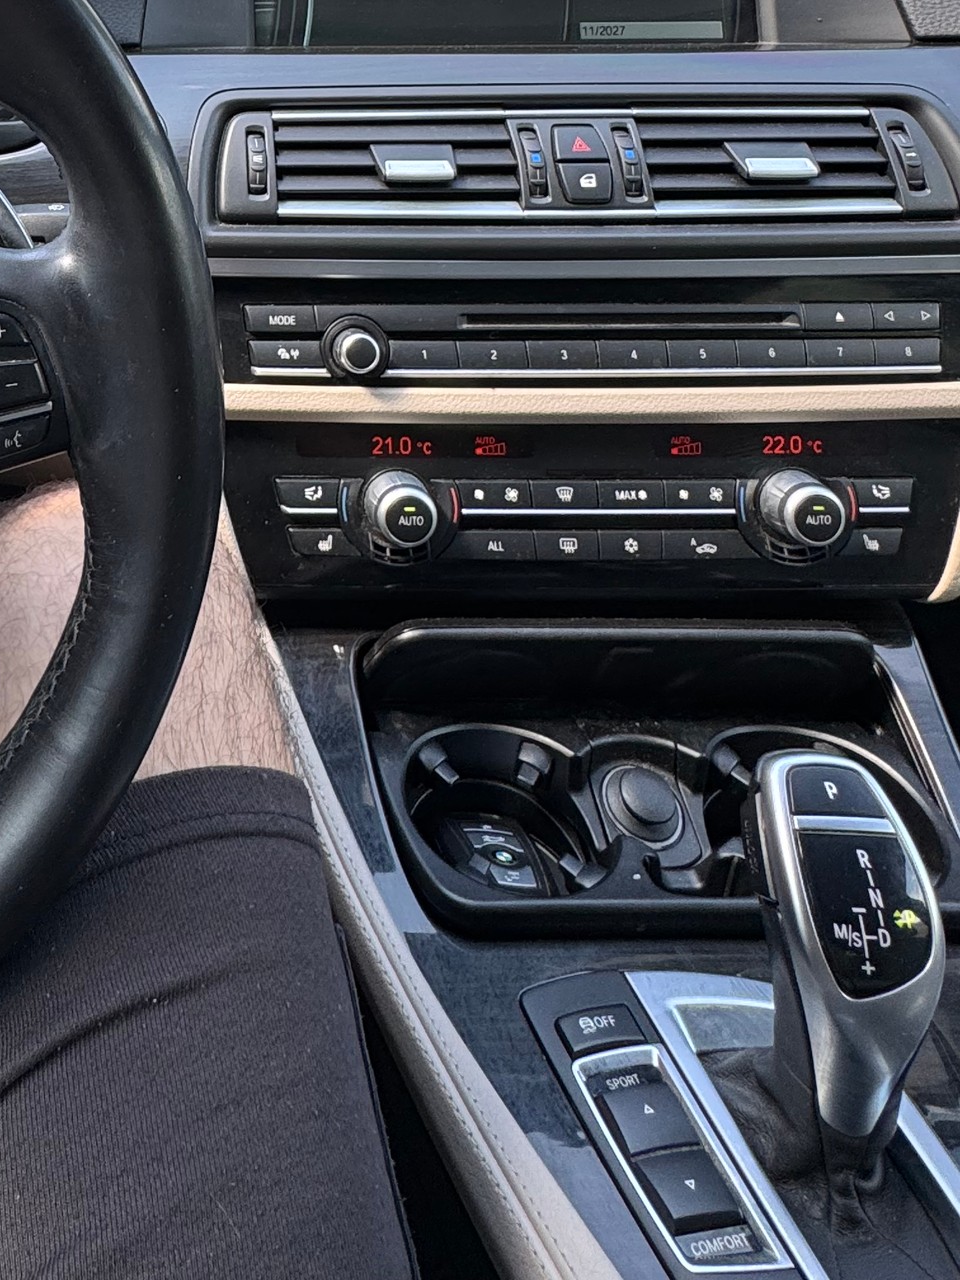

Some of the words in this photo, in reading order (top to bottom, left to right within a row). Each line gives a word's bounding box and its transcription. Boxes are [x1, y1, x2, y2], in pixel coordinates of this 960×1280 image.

[581, 25, 626, 37] 11/2027
[269, 315, 296, 326] MODE
[421, 349, 428, 359] 1
[490, 349, 498, 360] 2
[560, 349, 568, 360] 3
[630, 349, 638, 360] 4
[699, 348, 707, 359] 5
[768, 347, 776, 358] 6
[837, 346, 843, 357] 7
[905, 346, 912, 357] 8
[371, 435, 413, 456] 21.0
[475, 436, 496, 445] AUTO
[670, 436, 691, 445] AUTO
[762, 435, 803, 455] 22.0
[615, 489, 638, 501] MAX
[398, 515, 425, 527] AUTO
[805, 515, 833, 526] AUTO
[487, 540, 505, 552] ALL
[823, 780, 839, 800] P
[855, 848, 872, 869] R
[867, 887, 885, 909] N
[833, 922, 863, 948] M/S
[877, 927, 891, 948] D
[592, 1014, 616, 1028] OFF
[605, 1073, 641, 1091] SPORT
[690, 1232, 750, 1256] COMFORT
